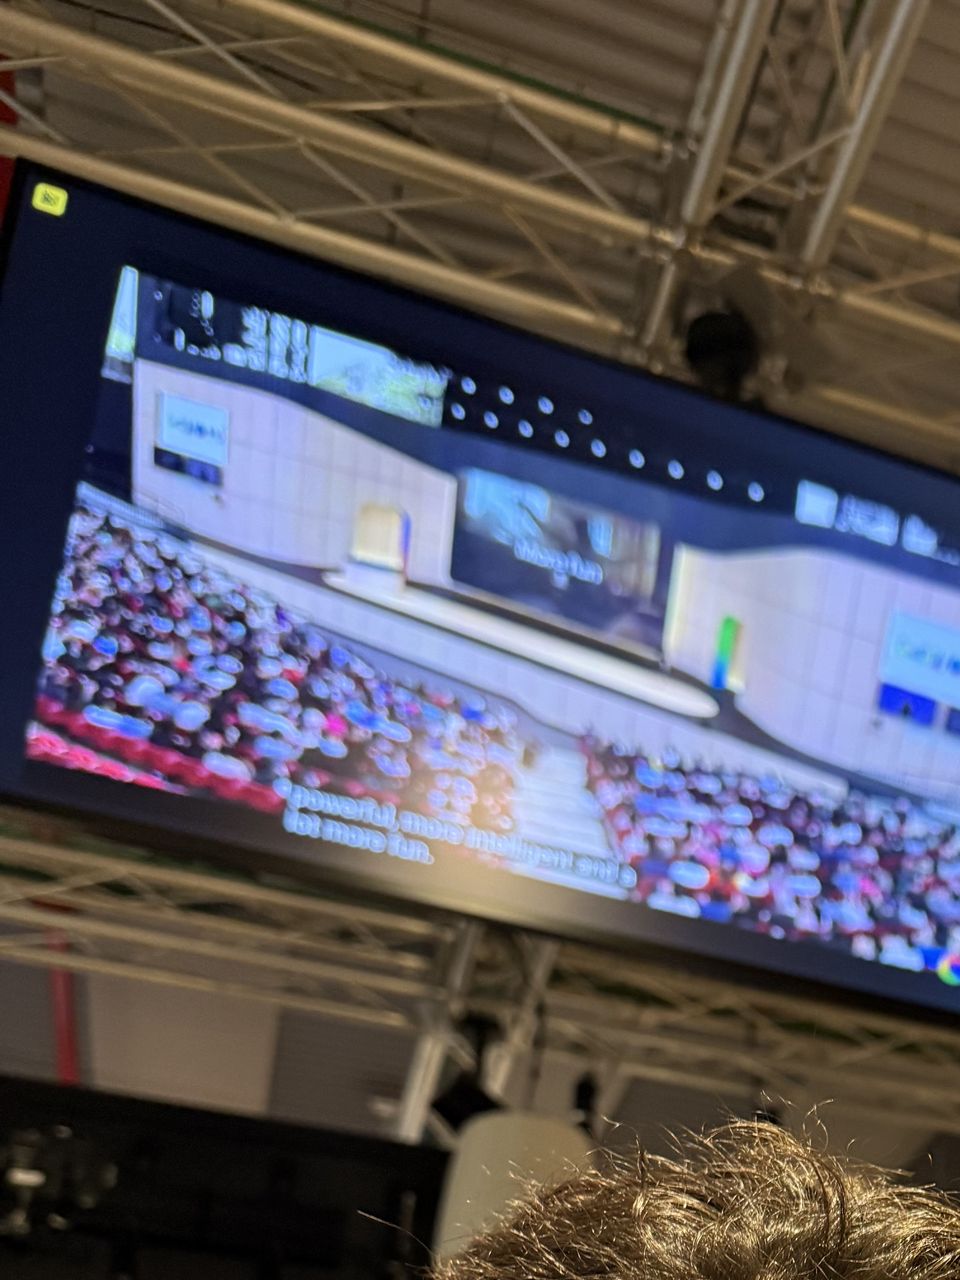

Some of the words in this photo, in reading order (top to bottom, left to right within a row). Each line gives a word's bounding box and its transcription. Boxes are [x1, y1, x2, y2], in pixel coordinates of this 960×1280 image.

[287, 783, 399, 832] powerful,
[400, 811, 464, 846] more
[465, 825, 574, 871] intelligent
[574, 850, 619, 884] and
[321, 818, 387, 854] more
